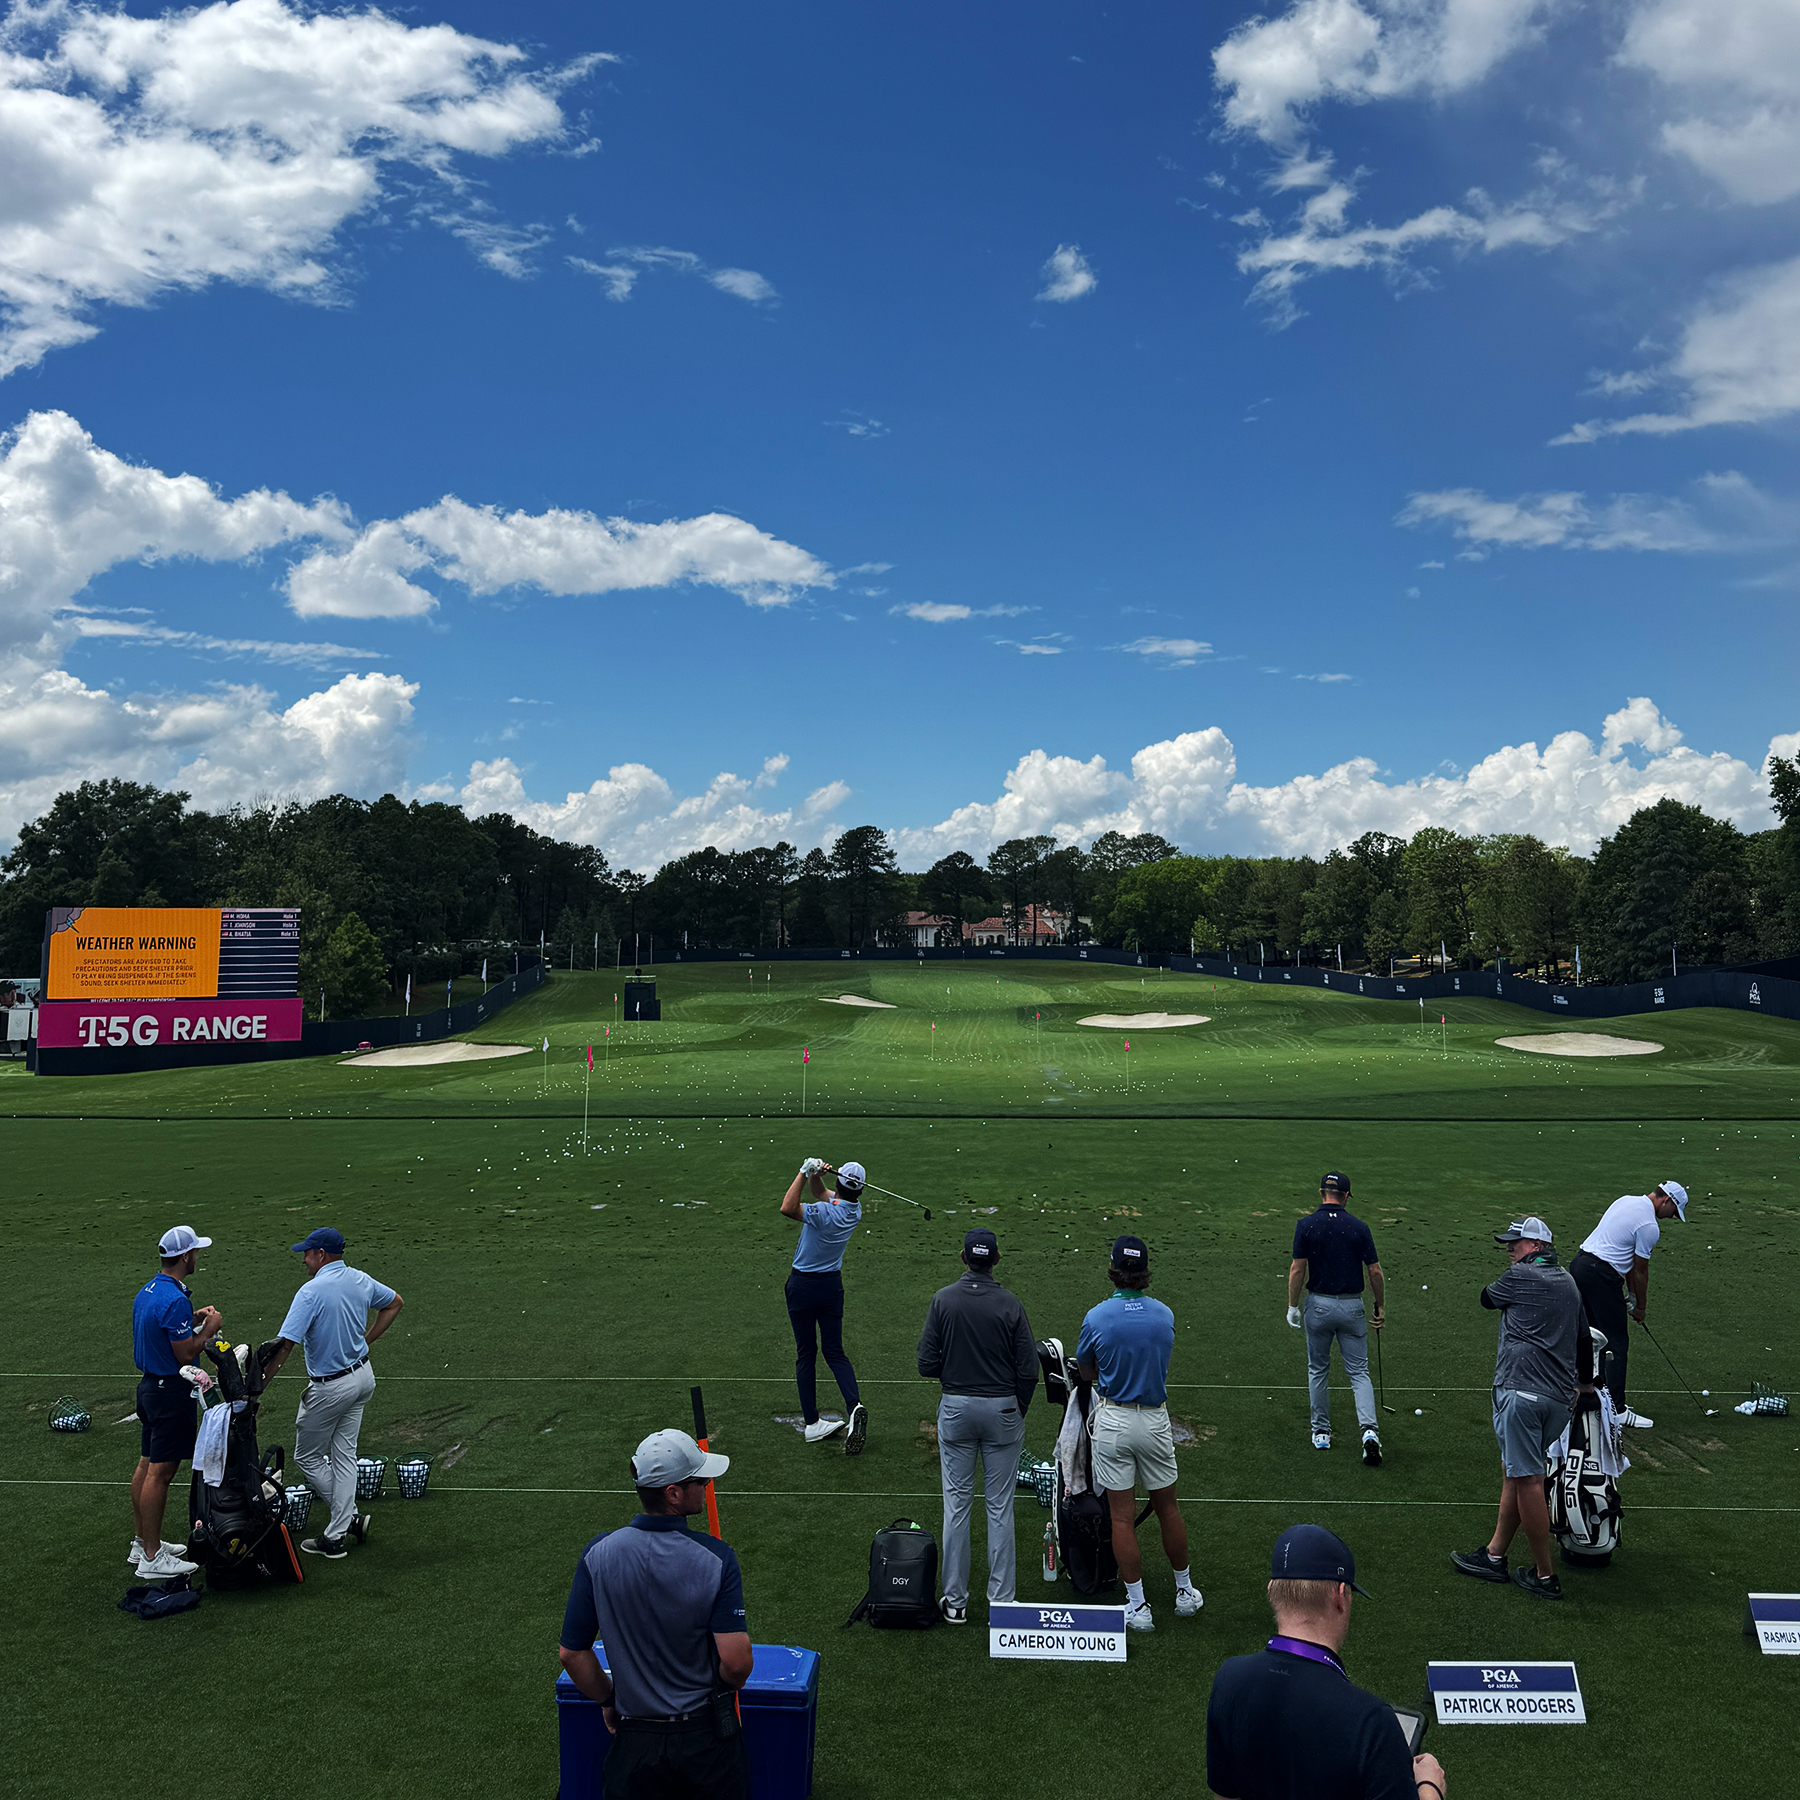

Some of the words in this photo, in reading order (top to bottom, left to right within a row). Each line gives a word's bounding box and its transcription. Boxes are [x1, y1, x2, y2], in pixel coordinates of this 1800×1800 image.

[76, 937, 134, 950] WEATHER
[139, 936, 196, 950] WARNING
[172, 1015, 267, 1041] RANGE
[1565, 1455, 1580, 1509] PING
[892, 1577, 909, 1586] DGY
[1038, 1610, 1075, 1623] PGA
[999, 1634, 1064, 1649] CAMERON
[1069, 1636, 1116, 1651] YOUNG
[1764, 1631, 1797, 1643] RASMUS
[1481, 1669, 1521, 1682] PGA
[1443, 1698, 1503, 1713] PATRICK
[1506, 1698, 1576, 1713] RODGERS
